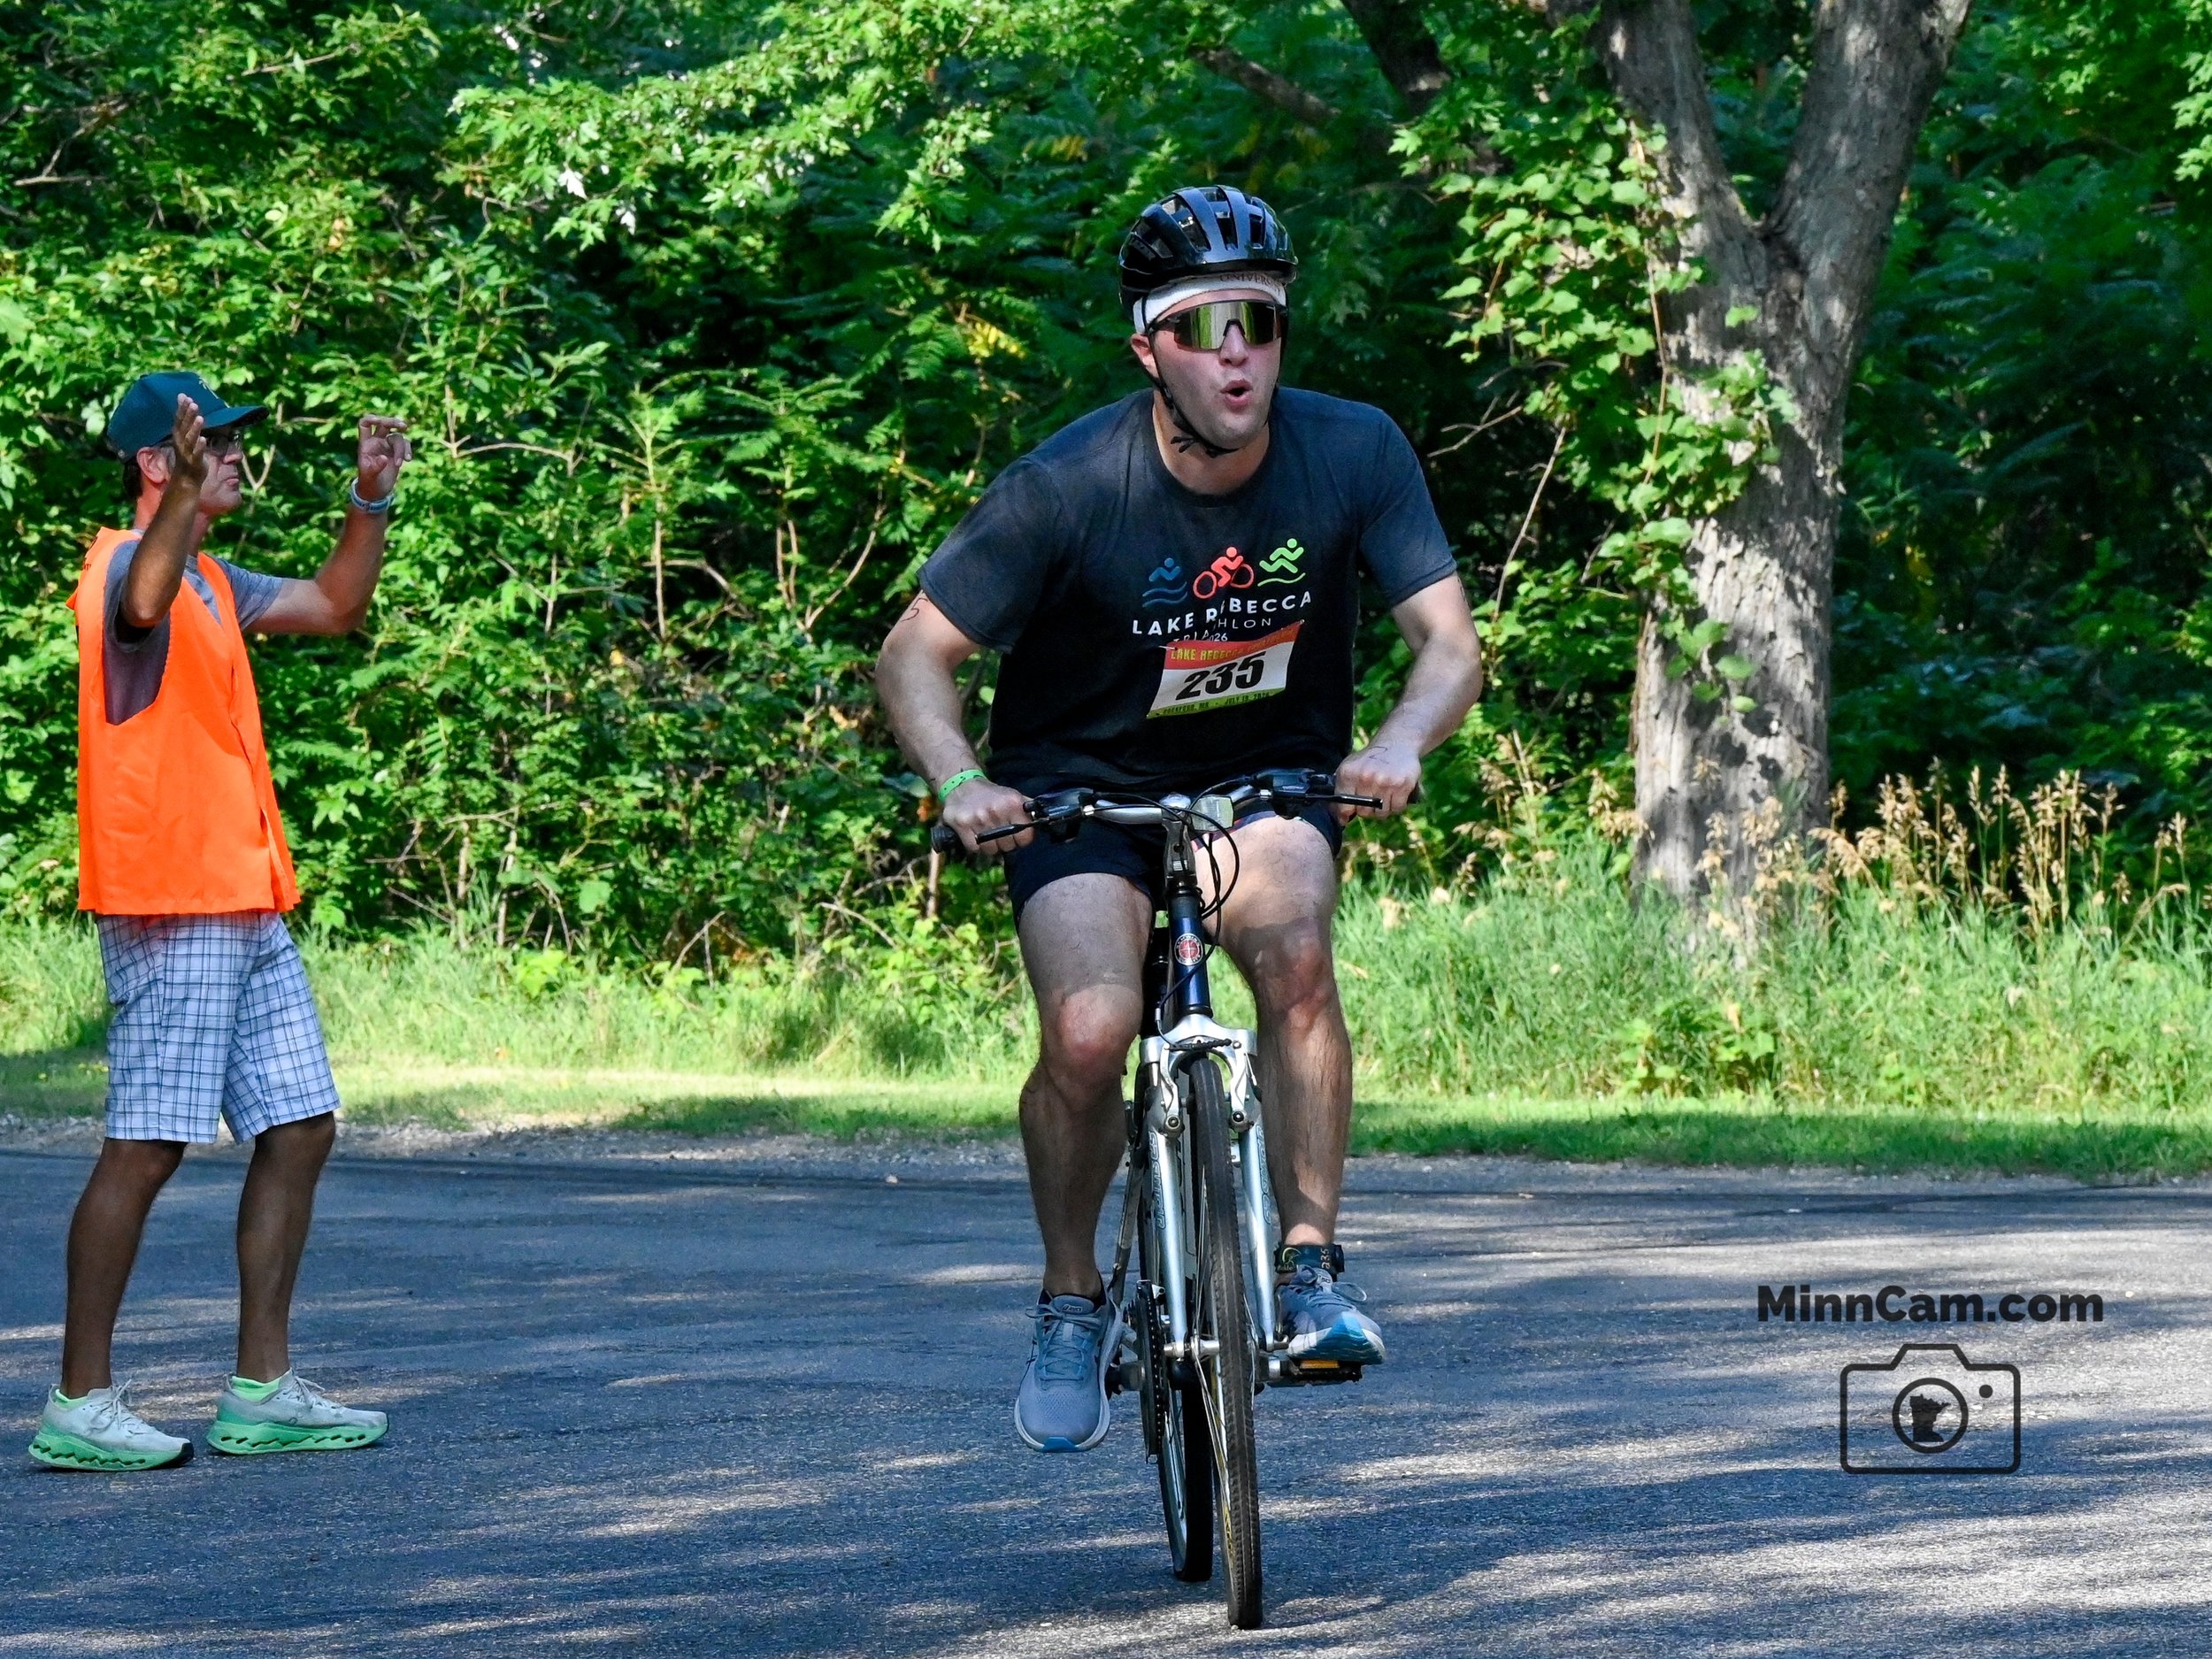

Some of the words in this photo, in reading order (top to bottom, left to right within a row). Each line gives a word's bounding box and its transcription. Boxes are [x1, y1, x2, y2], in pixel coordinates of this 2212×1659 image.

[1133, 611, 1194, 636] LAKE
[1173, 617, 1271, 642] RIAHLON
[1171, 648, 1195, 661] LAKE
[1176, 650, 1267, 701] 235
[1320, 1248, 1331, 1270] 235
